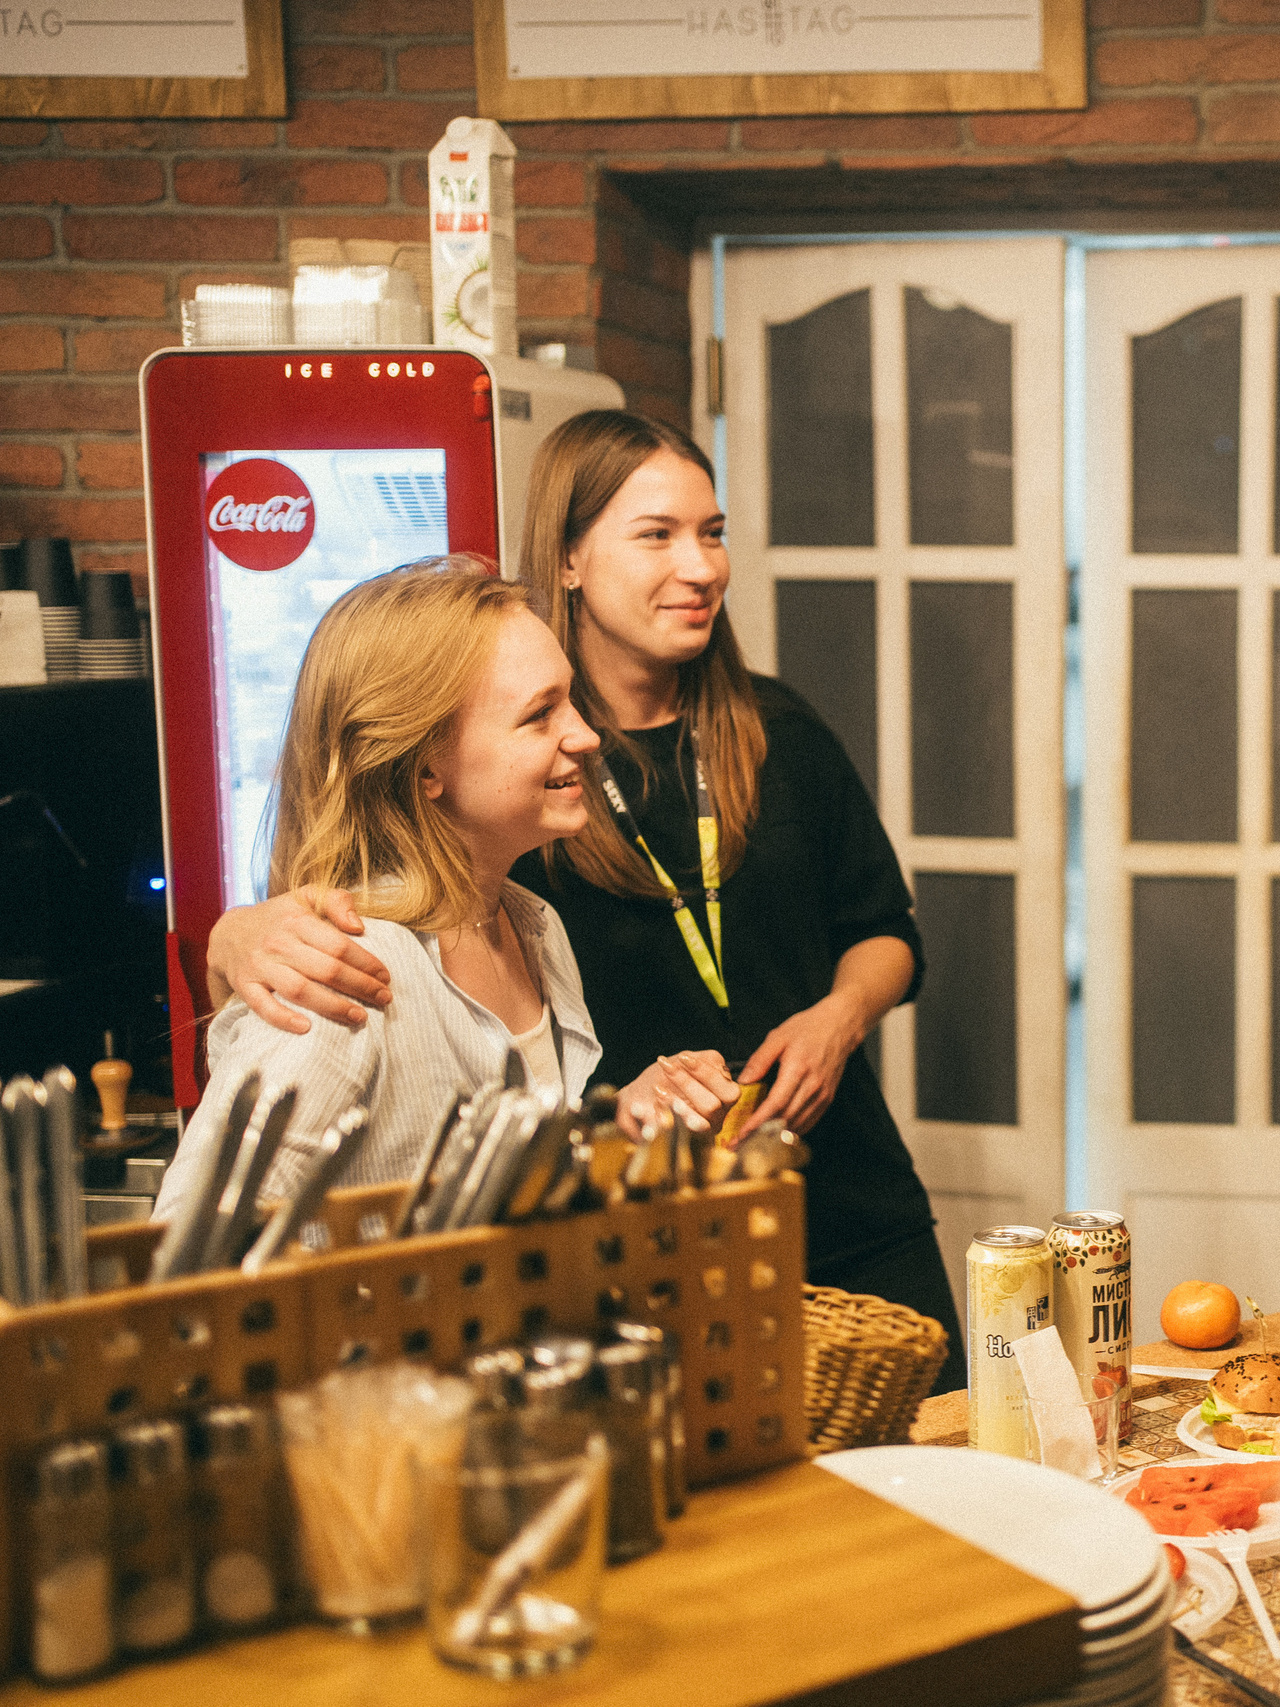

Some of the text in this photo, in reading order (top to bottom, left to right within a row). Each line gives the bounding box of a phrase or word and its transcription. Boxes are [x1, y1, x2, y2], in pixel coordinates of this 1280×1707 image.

[284, 362, 435, 378] ICE COLD
[602, 779, 627, 813] SEXY
[1092, 1278, 1131, 1303] МИСТ
[1088, 1297, 1131, 1344] ЛИ
[986, 1334, 1015, 1358] Ho
